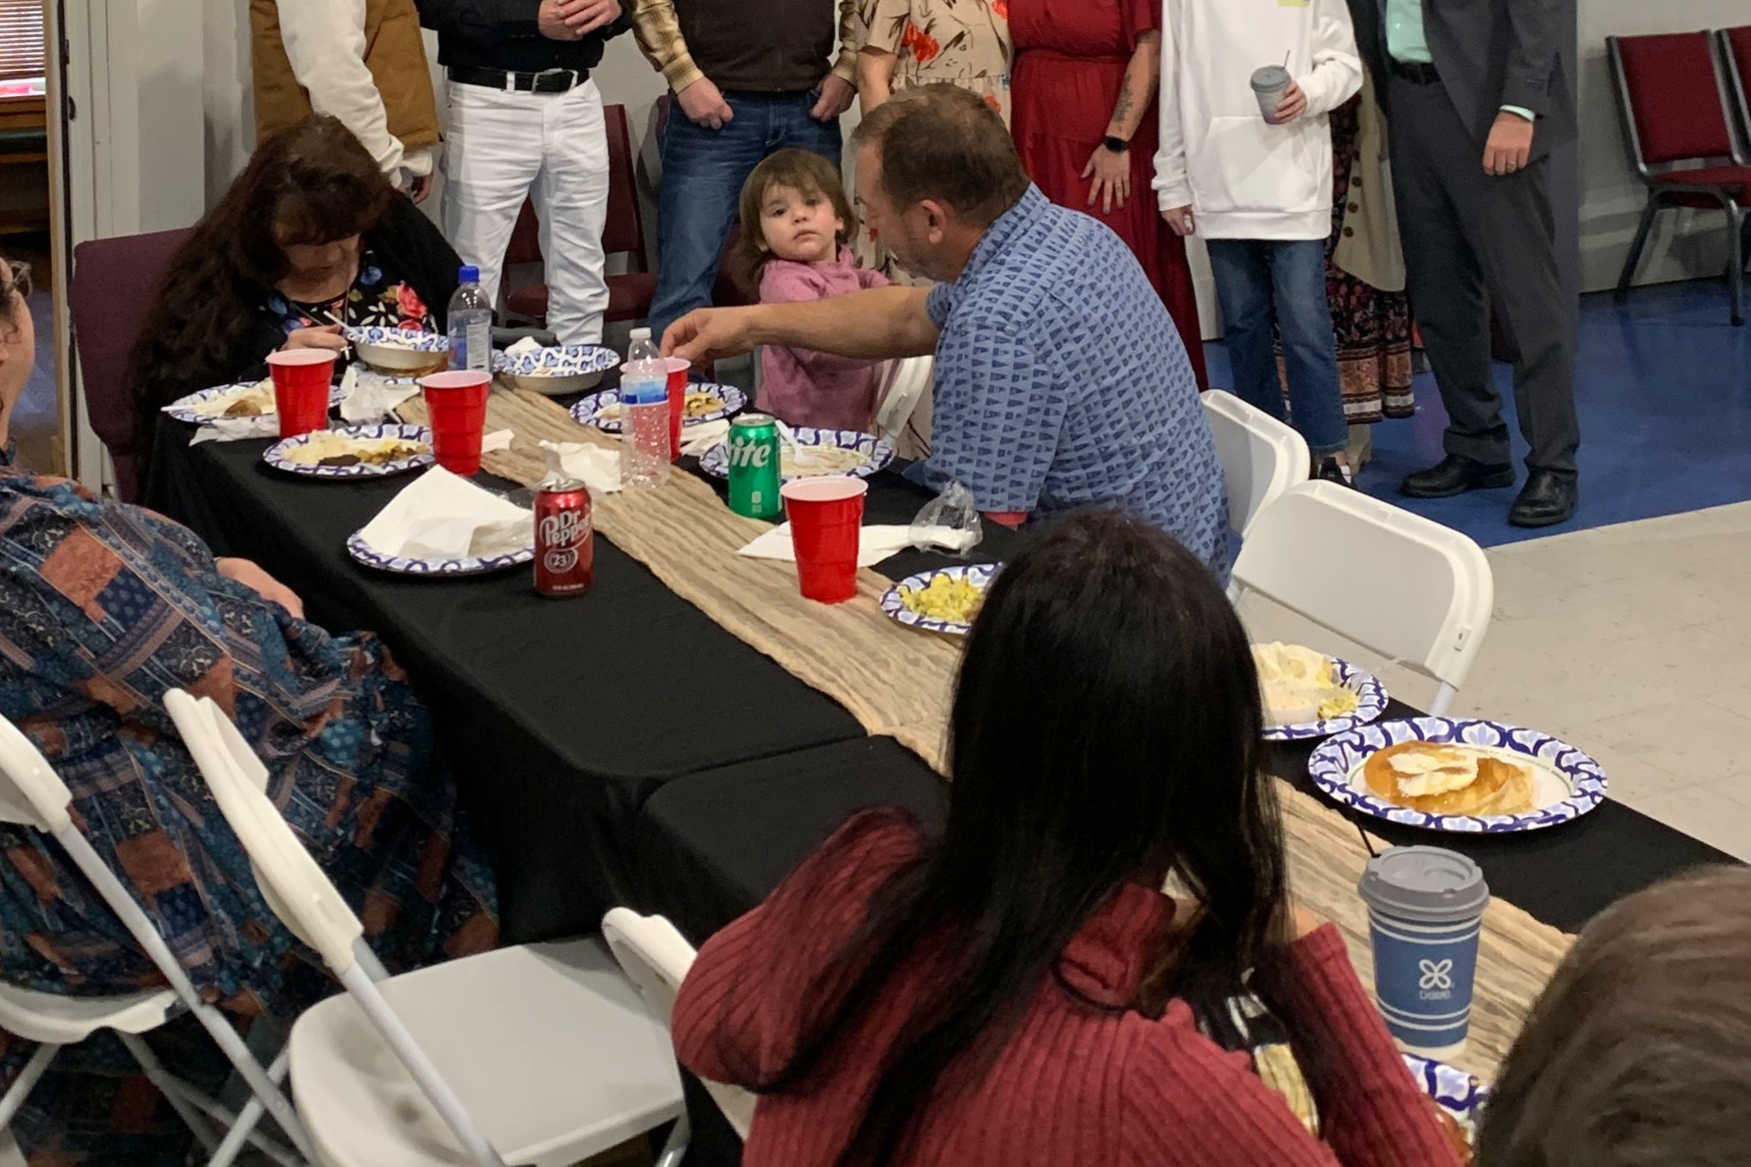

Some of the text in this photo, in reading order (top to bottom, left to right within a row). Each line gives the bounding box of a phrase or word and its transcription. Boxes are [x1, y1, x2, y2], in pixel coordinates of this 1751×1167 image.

[730, 436, 771, 467] ite
[540, 514, 590, 547] Pepper
[560, 511, 581, 529] Dr
[553, 554, 567, 567] 23
